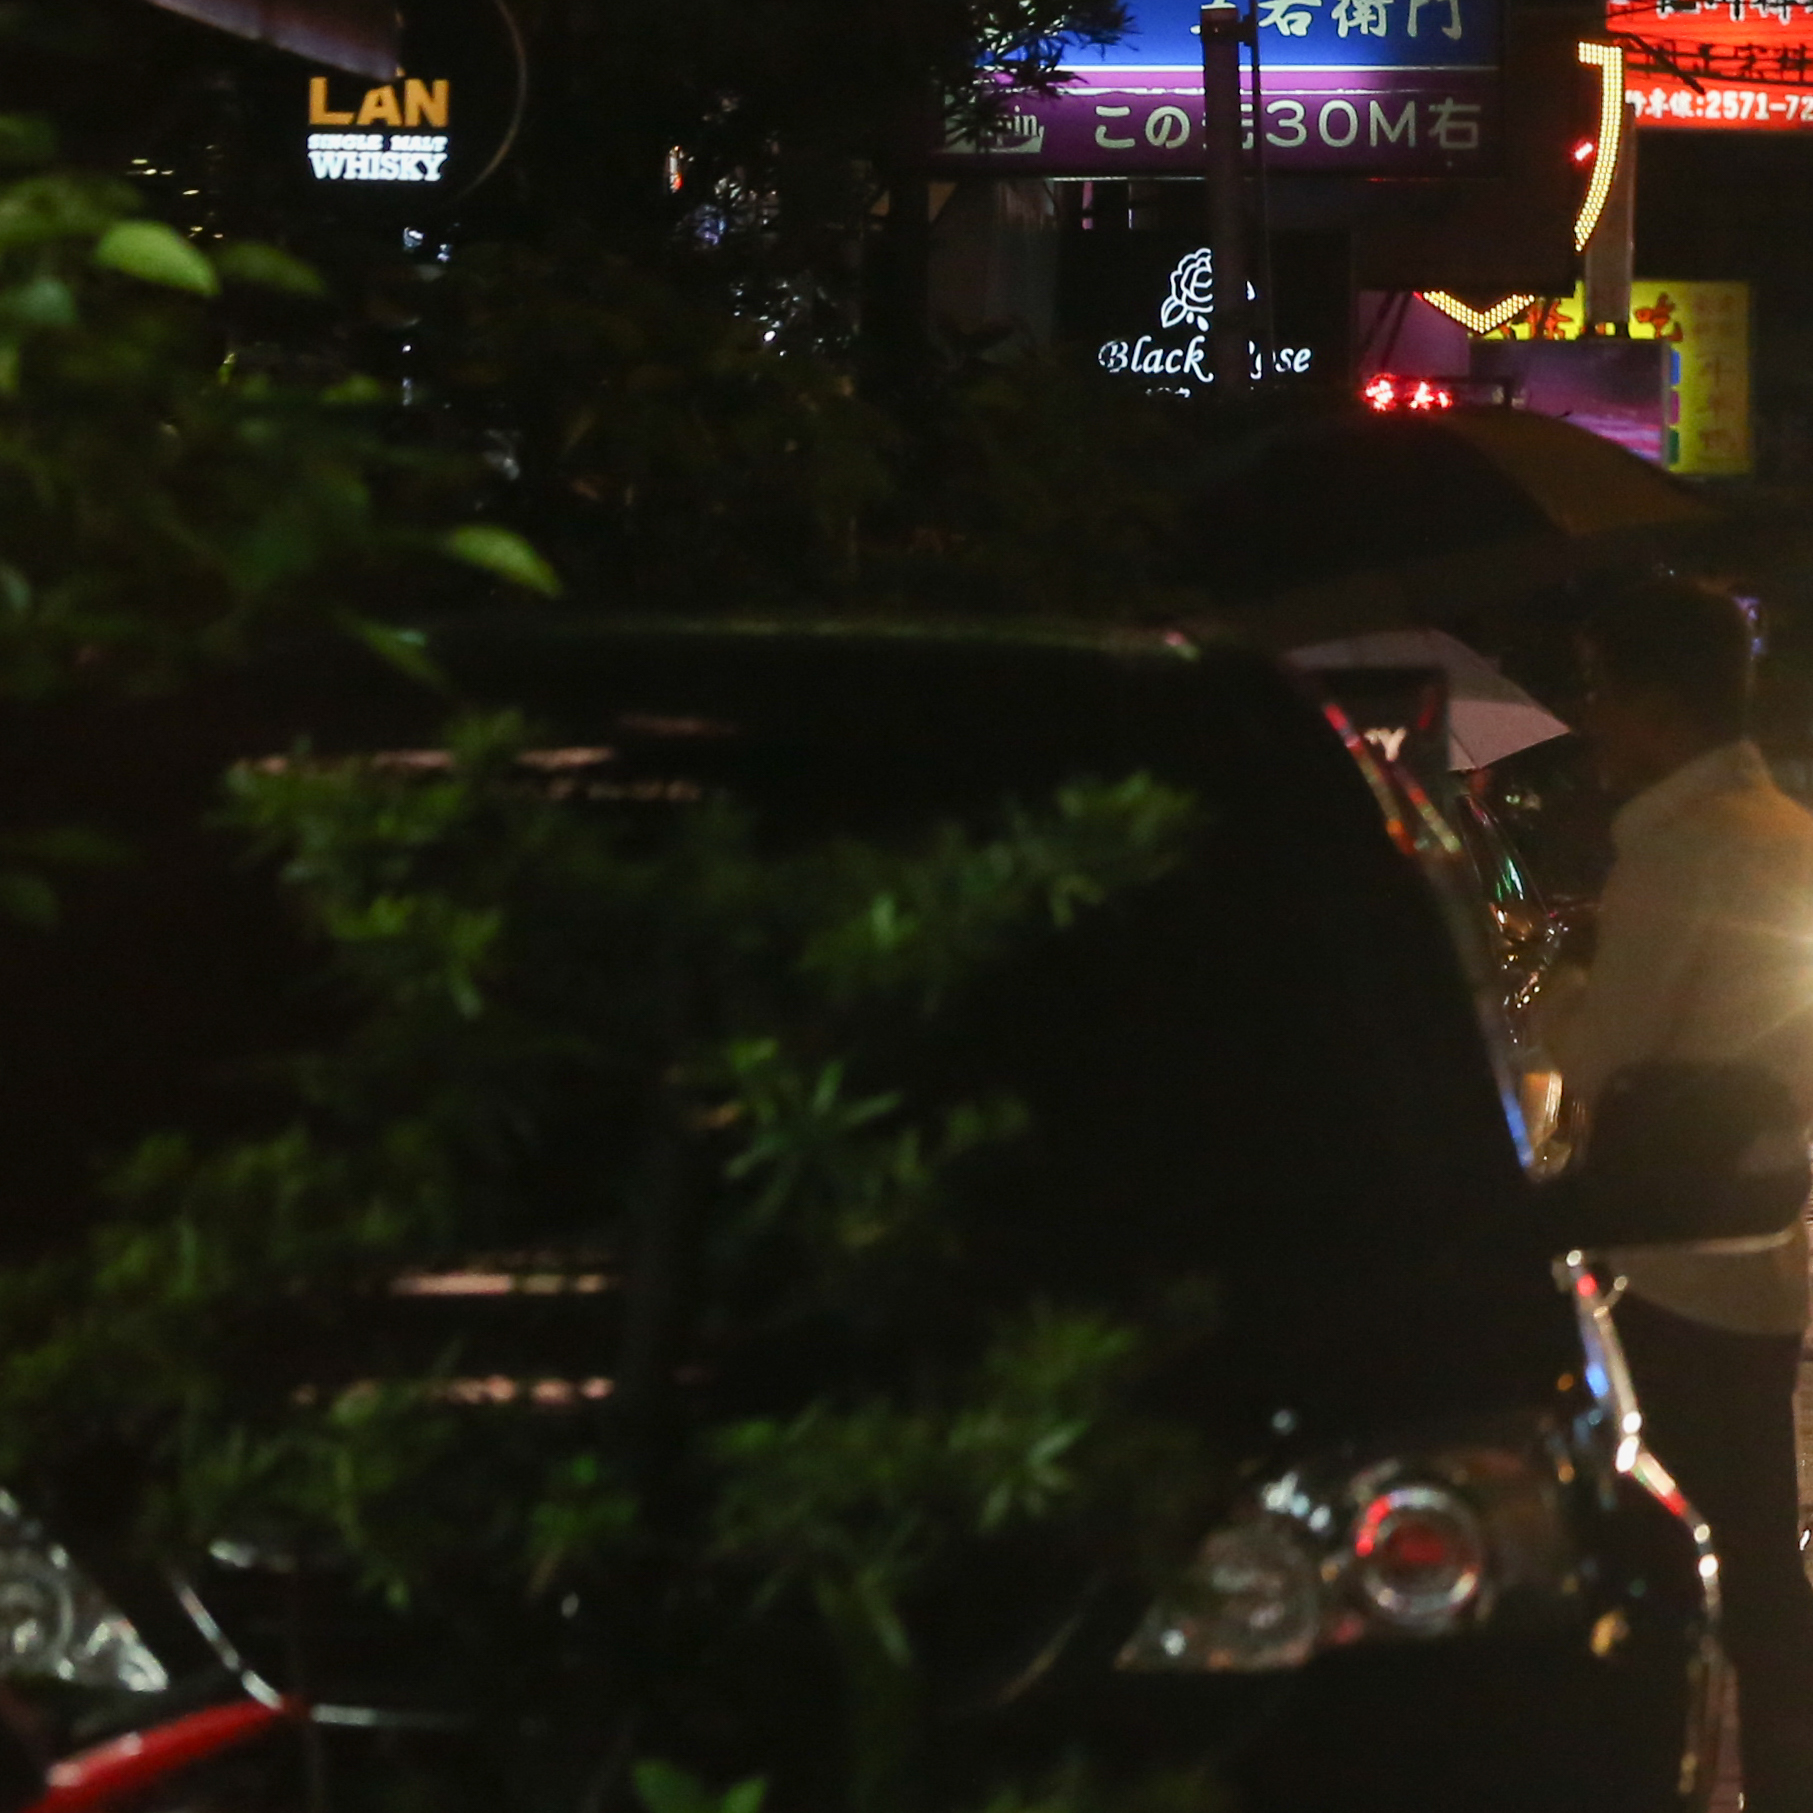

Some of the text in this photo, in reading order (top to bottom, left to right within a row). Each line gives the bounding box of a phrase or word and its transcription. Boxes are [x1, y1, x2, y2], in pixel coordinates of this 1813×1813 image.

[308, 76, 450, 128] LAN
[307, 150, 448, 181] WHISKY
[1098, 335, 1215, 383] Black
